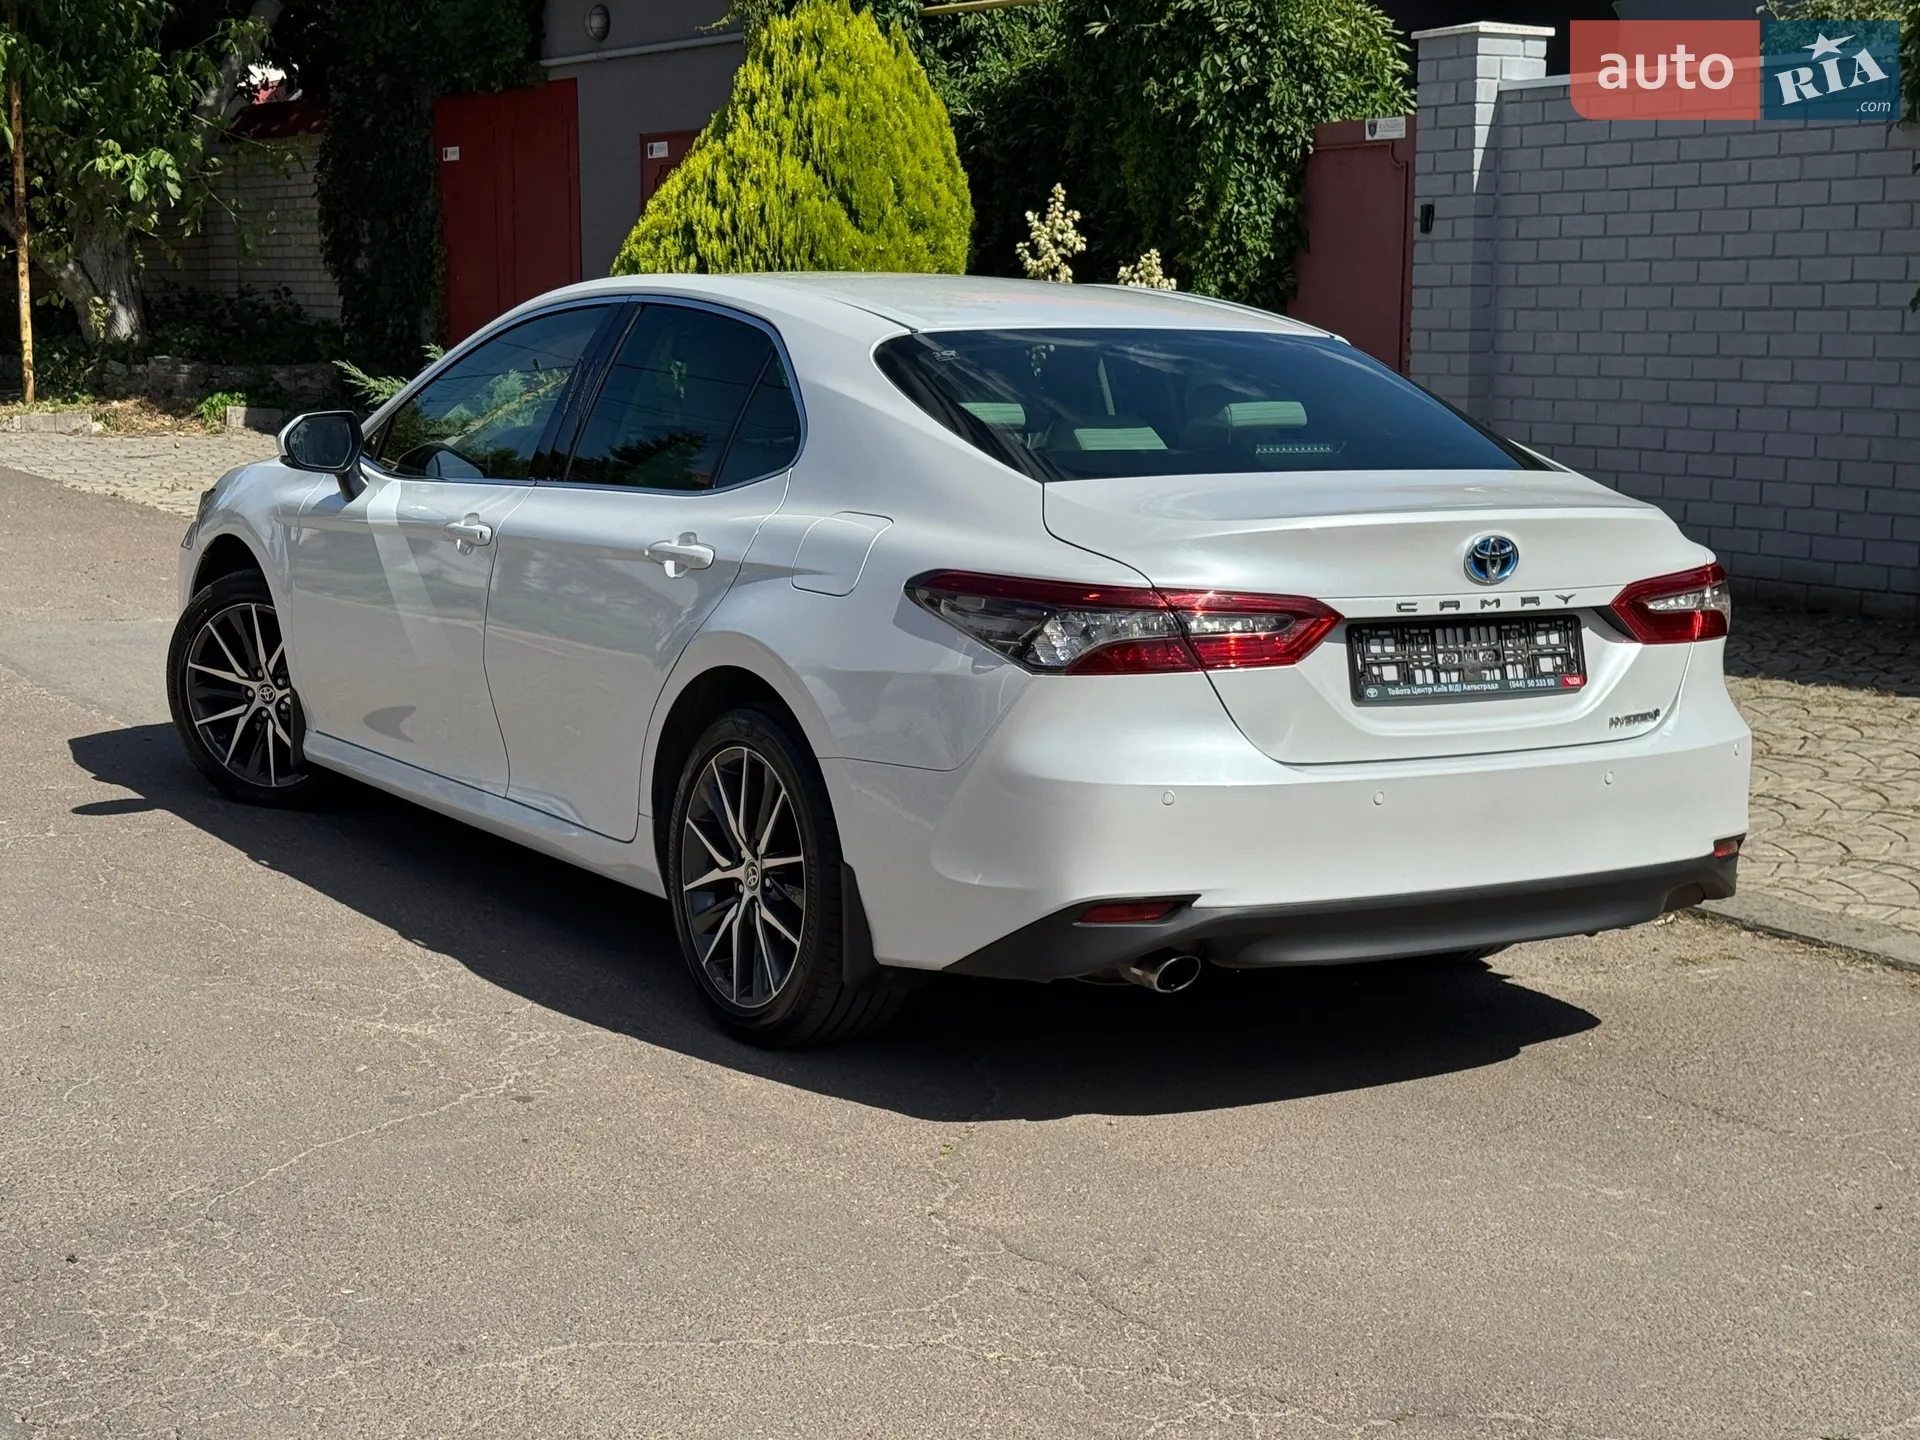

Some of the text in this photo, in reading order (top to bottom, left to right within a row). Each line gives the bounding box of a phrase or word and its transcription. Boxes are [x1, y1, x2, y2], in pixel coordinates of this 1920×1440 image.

[1396, 593, 1577, 613] CAMRY
[1411, 686, 1433, 695] Центр
[1462, 683, 1499, 691] Автострада
